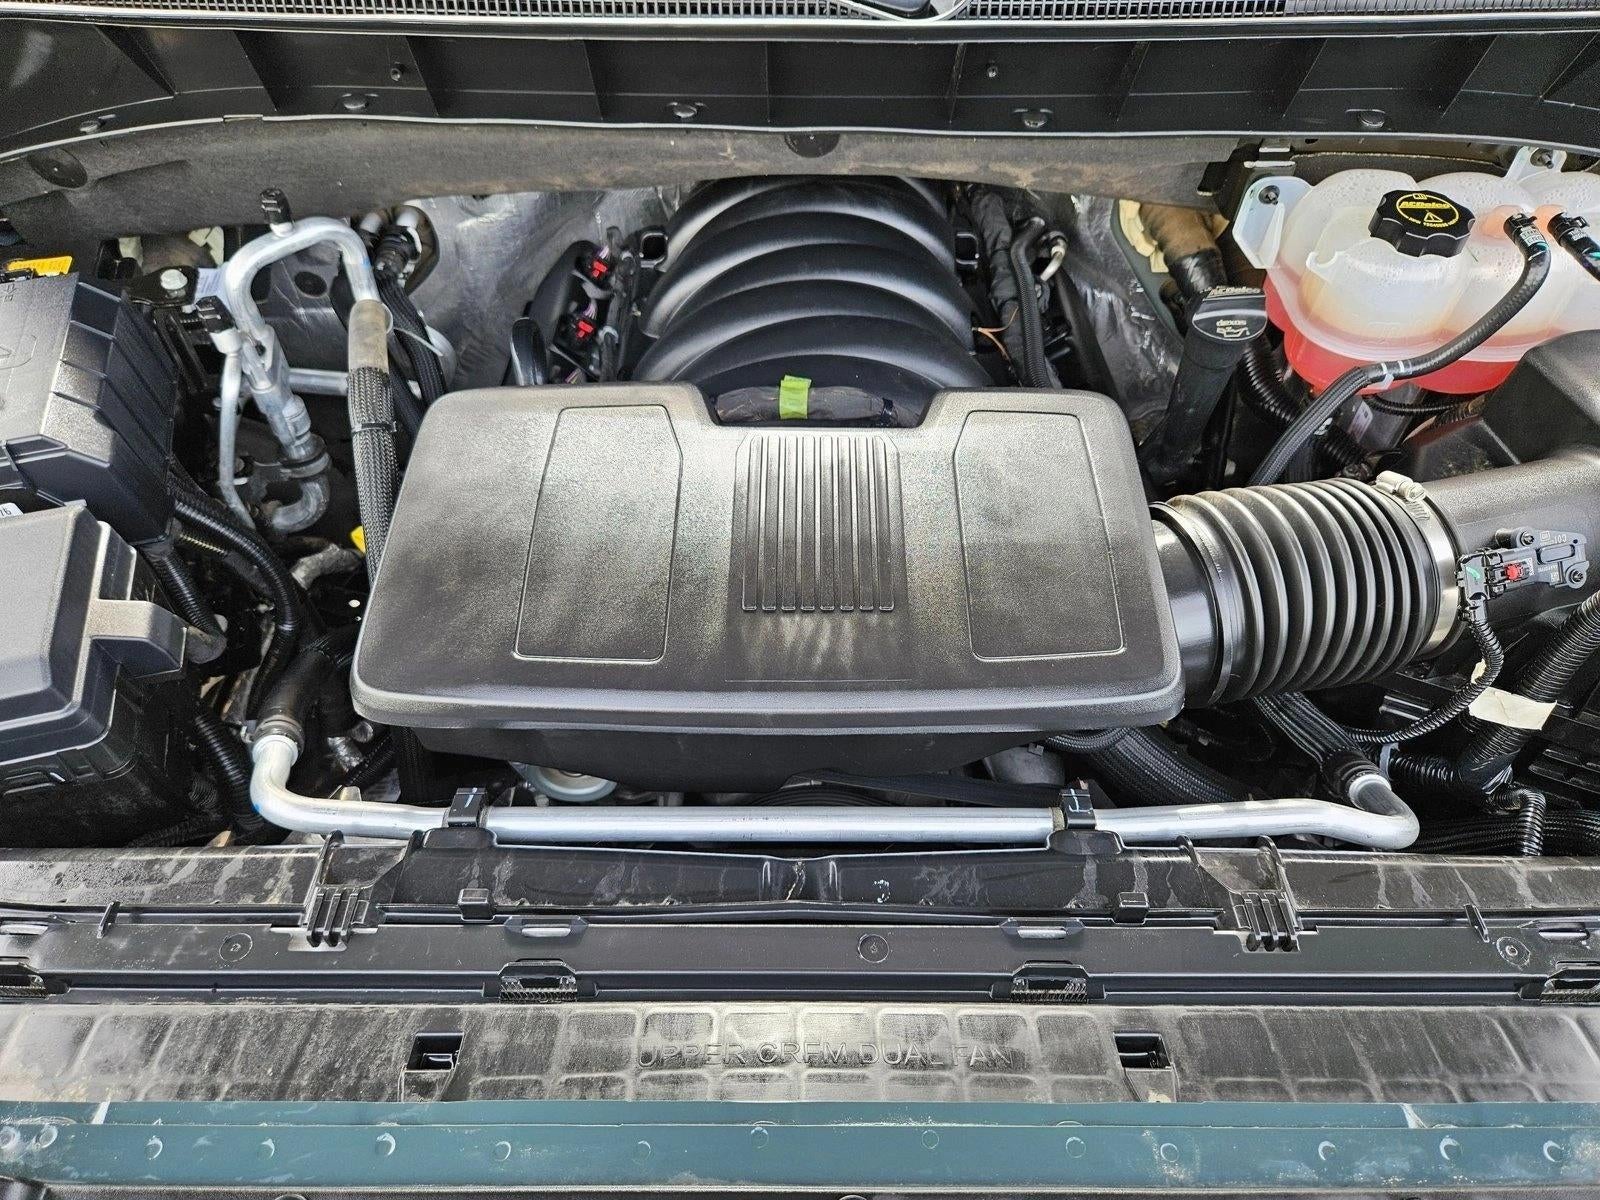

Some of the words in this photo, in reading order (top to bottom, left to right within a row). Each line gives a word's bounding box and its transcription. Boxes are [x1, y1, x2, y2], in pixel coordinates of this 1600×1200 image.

[1216, 319, 1247, 327] dexos
[637, 1042, 746, 1067] UPPER
[758, 1041, 847, 1064] CRFM
[859, 1043, 944, 1066] DUAL
[953, 1045, 1014, 1067] FAN
